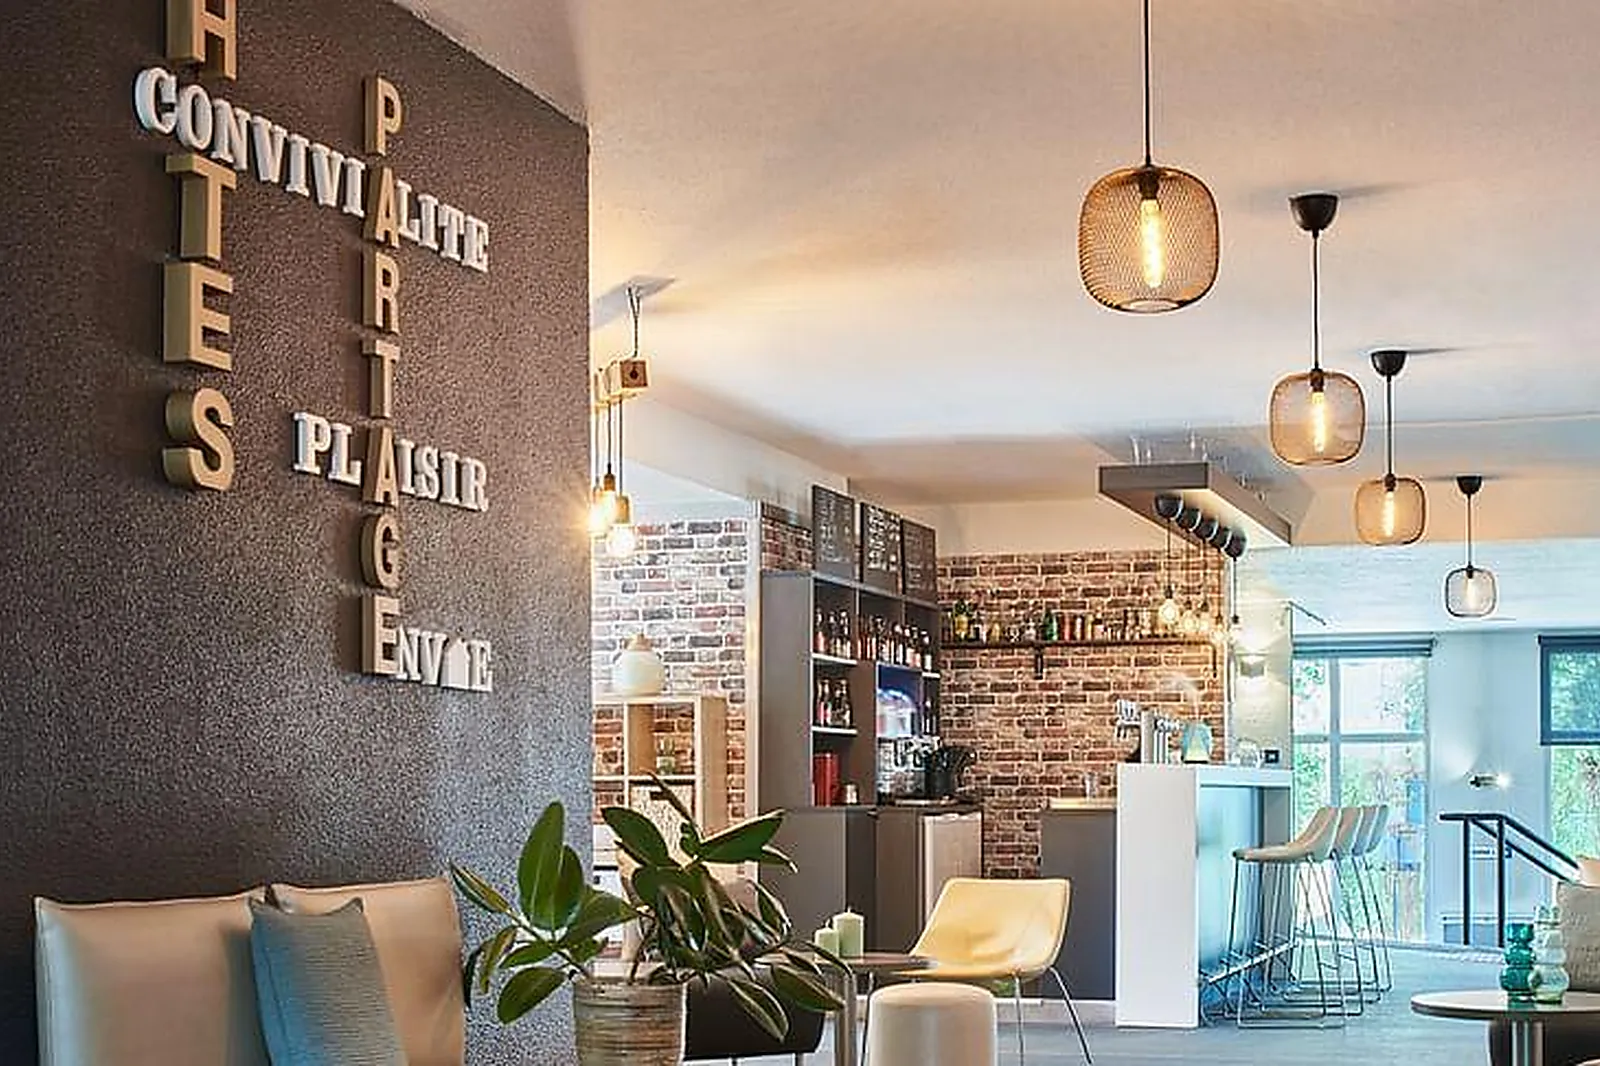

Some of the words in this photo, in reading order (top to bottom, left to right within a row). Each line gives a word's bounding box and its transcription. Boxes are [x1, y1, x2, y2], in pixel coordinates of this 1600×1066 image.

[134, 66, 490, 273] CONVIVIALITE
[293, 411, 490, 512] PLAISIR
[362, 75, 403, 677] PARTAGE
